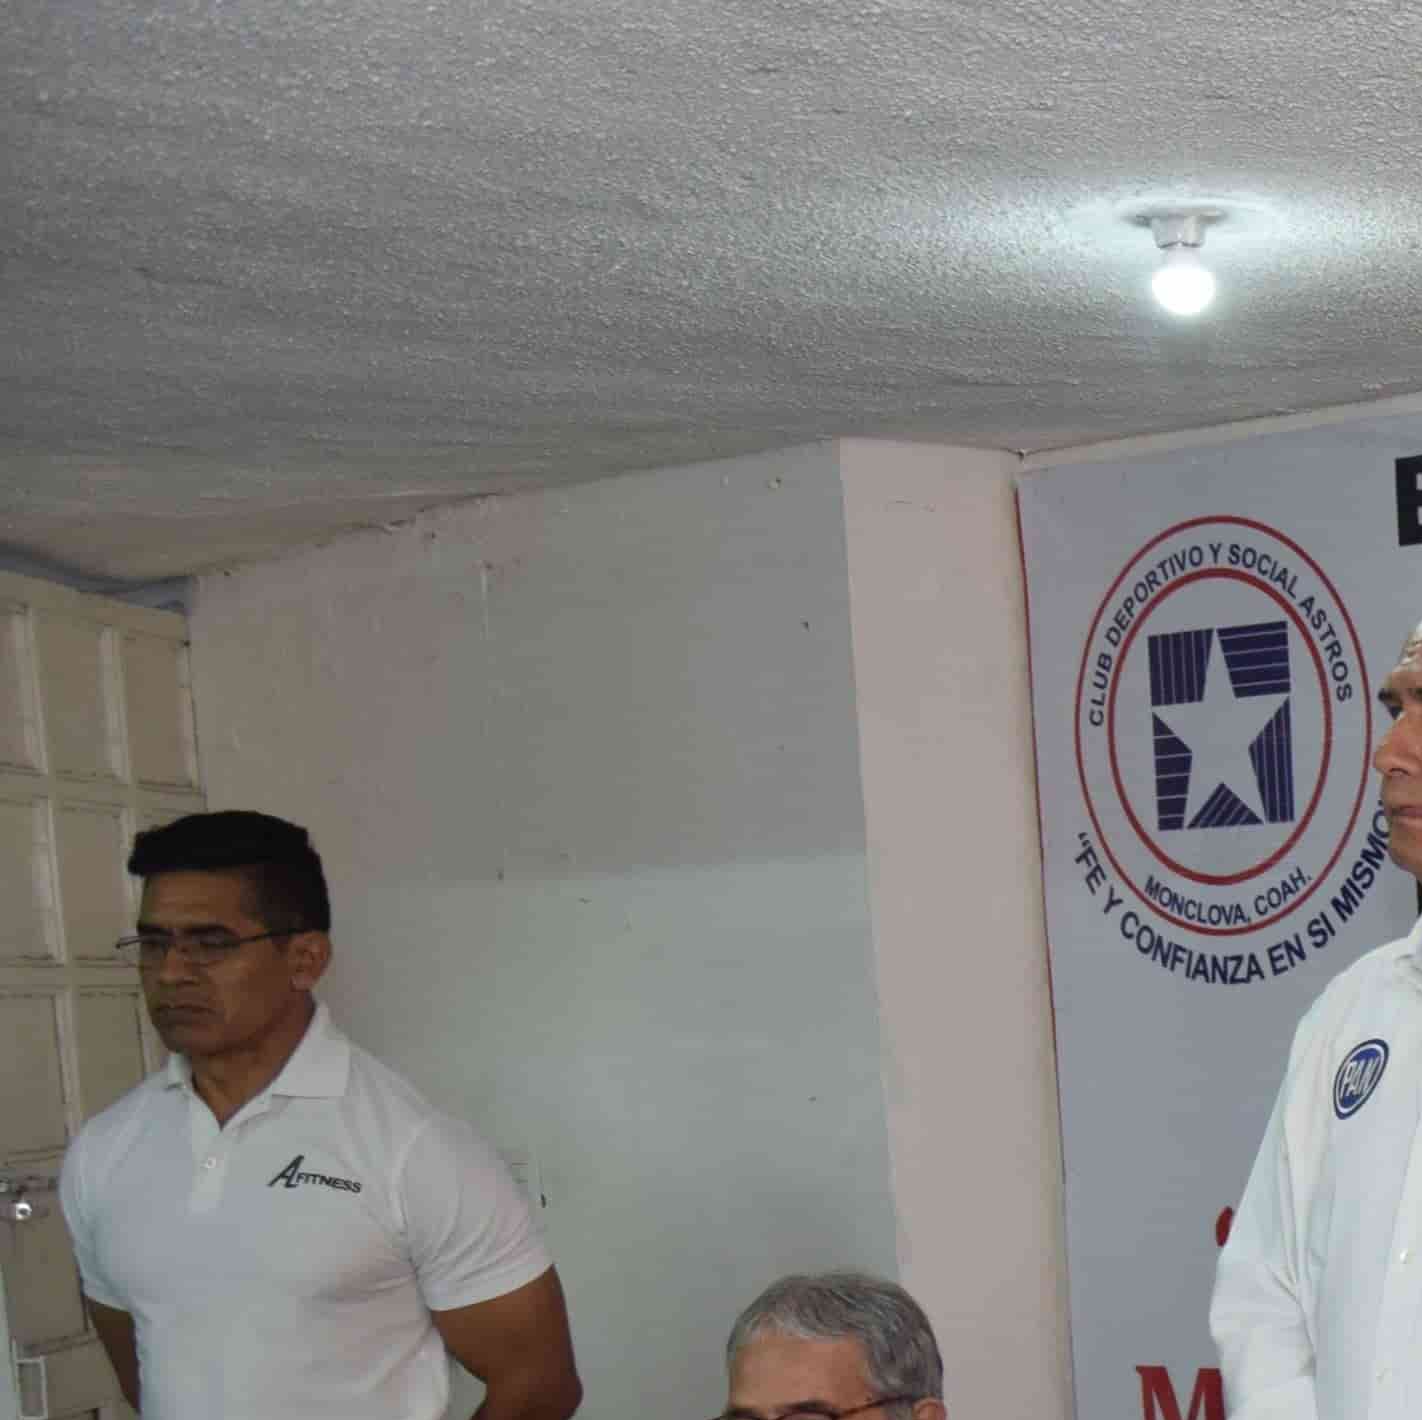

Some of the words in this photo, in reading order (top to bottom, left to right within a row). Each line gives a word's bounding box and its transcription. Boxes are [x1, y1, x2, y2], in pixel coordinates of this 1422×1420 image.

[1089, 653, 1113, 727] CLUB
[1105, 545, 1204, 648] DEPORTIVO
[1208, 543, 1223, 563] Y
[1227, 544, 1299, 598] SOCIAL
[1297, 596, 1352, 702] ASTROS
[1102, 884, 1123, 915] Y
[1120, 911, 1265, 984] CONFIANZA
[1267, 933, 1306, 977] EN
[1307, 911, 1336, 949] SI
[1254, 866, 1311, 916] COAH.
